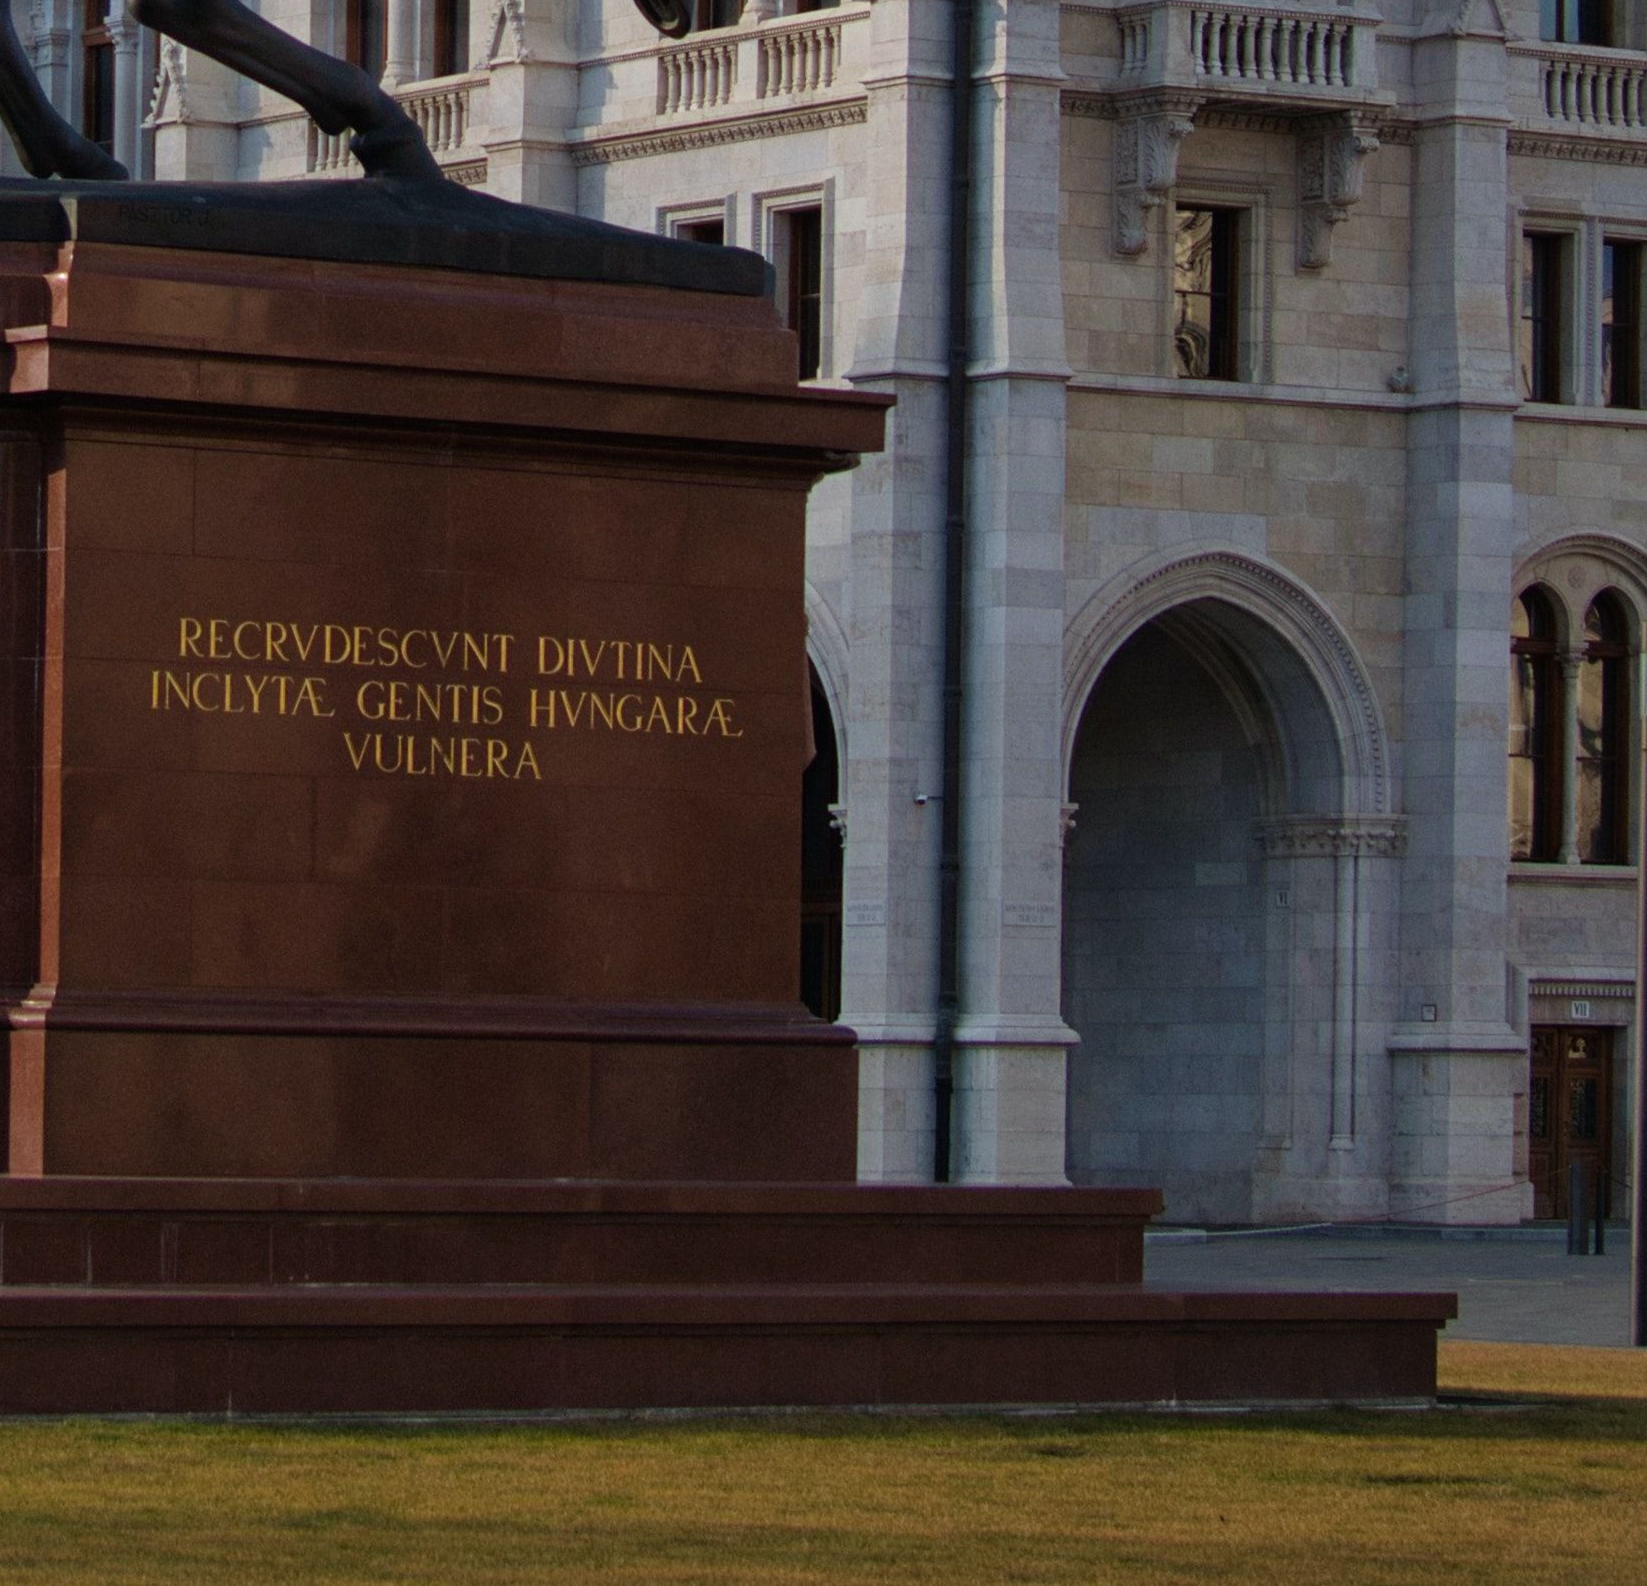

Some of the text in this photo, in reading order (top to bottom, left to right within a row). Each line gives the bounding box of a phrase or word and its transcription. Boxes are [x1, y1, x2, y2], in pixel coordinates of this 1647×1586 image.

[179, 618, 703, 683] RECRVDESCVNT DIVTINA
[151, 671, 743, 737] INCLYTÆ GENTIS HVNGARÆ
[343, 732, 543, 780] VULNERA
